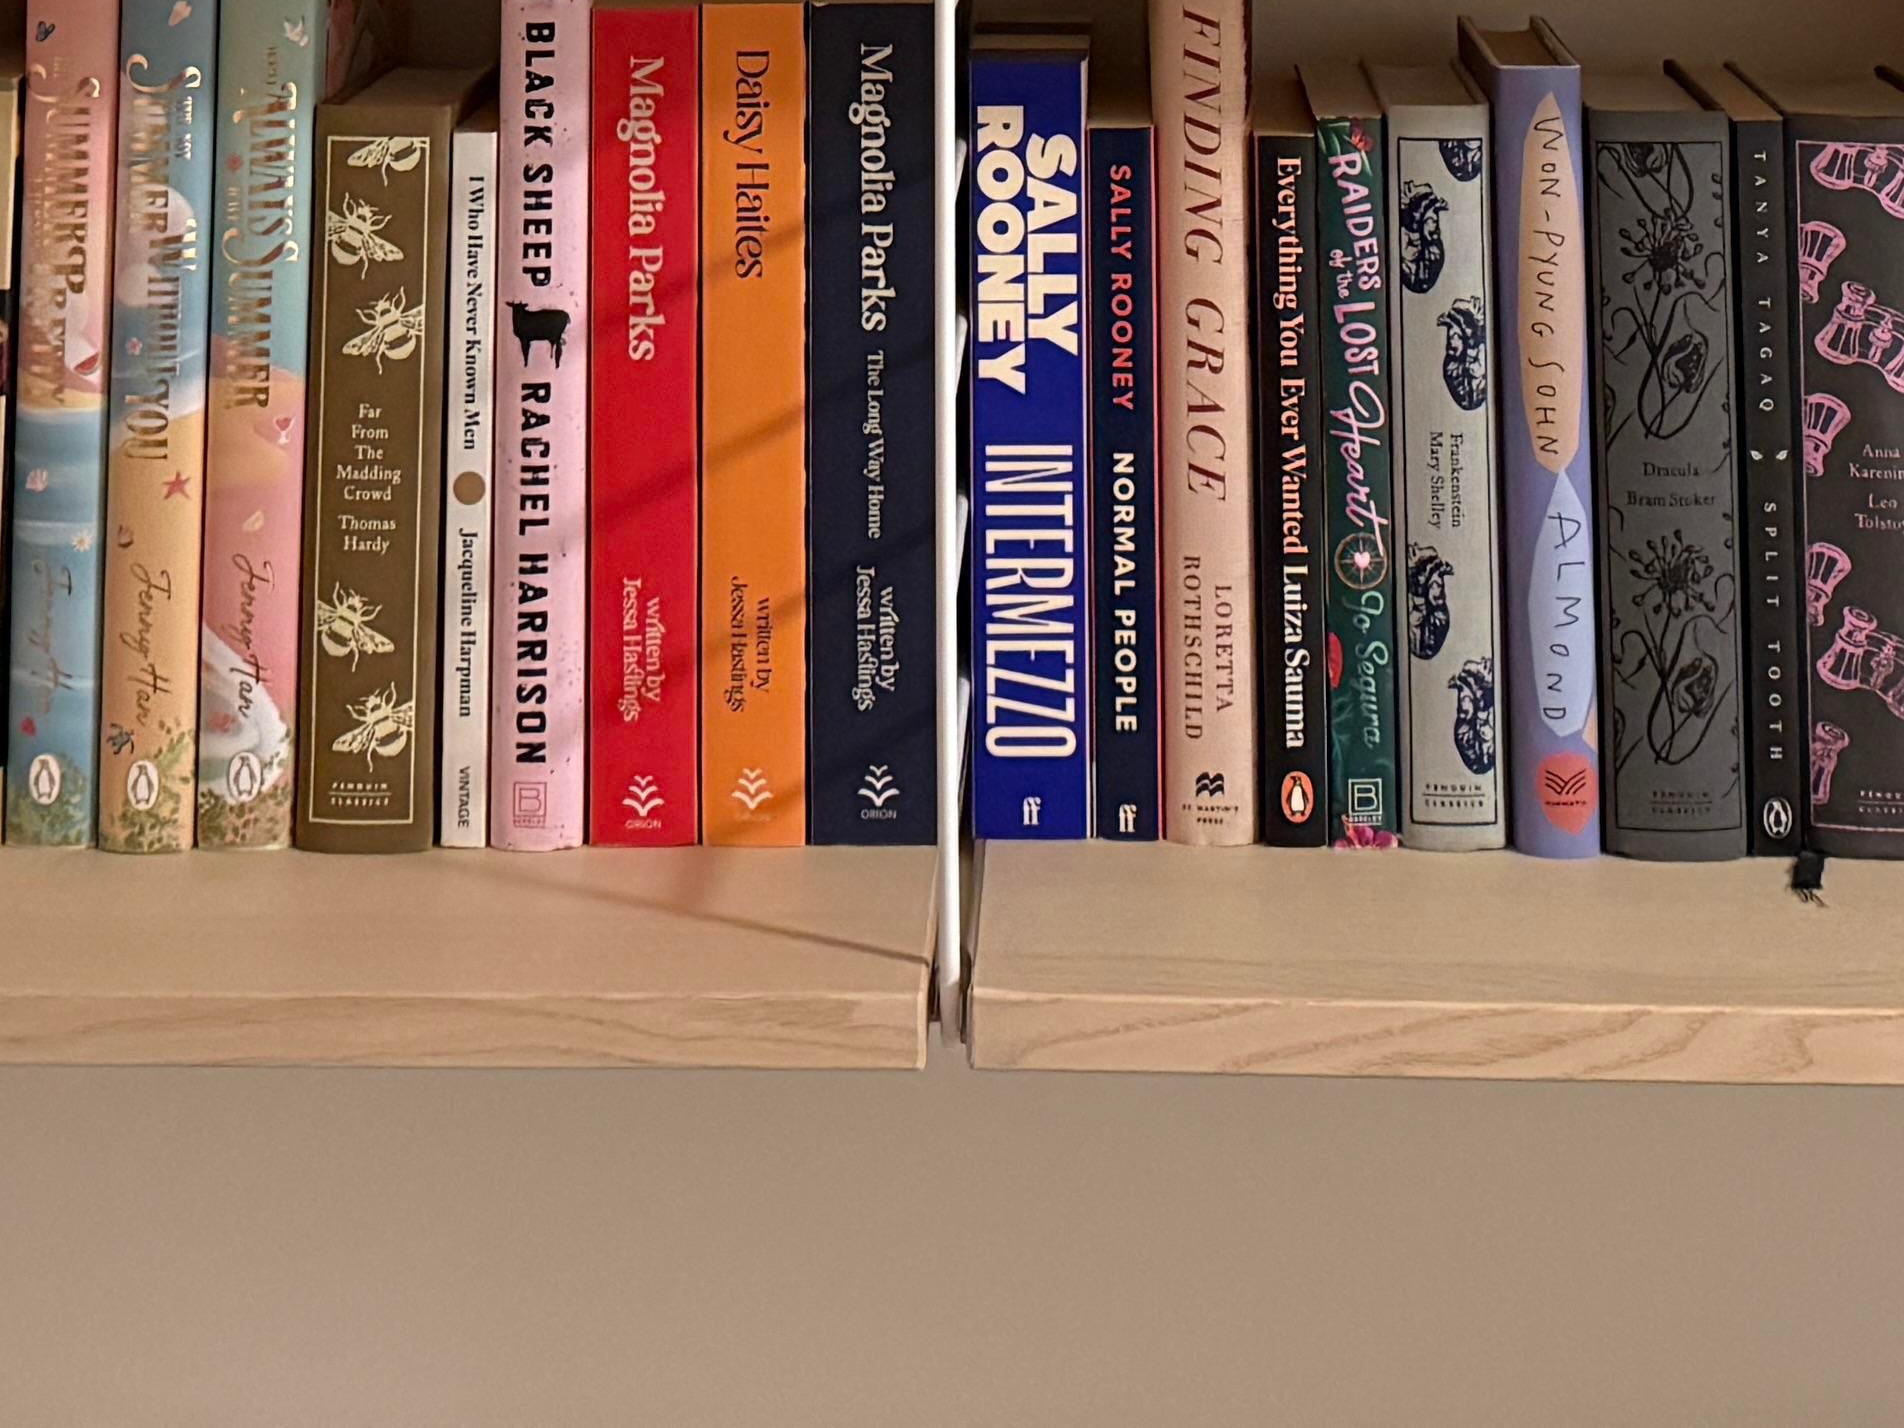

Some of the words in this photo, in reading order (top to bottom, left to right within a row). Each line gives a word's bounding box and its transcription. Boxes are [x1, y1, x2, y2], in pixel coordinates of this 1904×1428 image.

[520, 20, 558, 155] BLACK
[521, 165, 554, 290] SHEEP
[974, 104, 1029, 395] ROONEY
[1023, 131, 1081, 358] SALLY
[358, 404, 383, 420] Far
[351, 424, 389, 439] From
[354, 444, 386, 460] The
[1862, 444, 1901, 458] Anna
[336, 465, 403, 484] Madding
[343, 485, 392, 503] Crowd
[1867, 494, 1898, 511] Leo
[337, 515, 397, 531] Thomas
[1112, 451, 1138, 593] NORMAL
[343, 536, 391, 554] Hardy
[983, 442, 1078, 760] INTERMEZZO
[1543, 510, 1587, 723] ALMOND
[1114, 608, 1140, 734] PEOPLE
